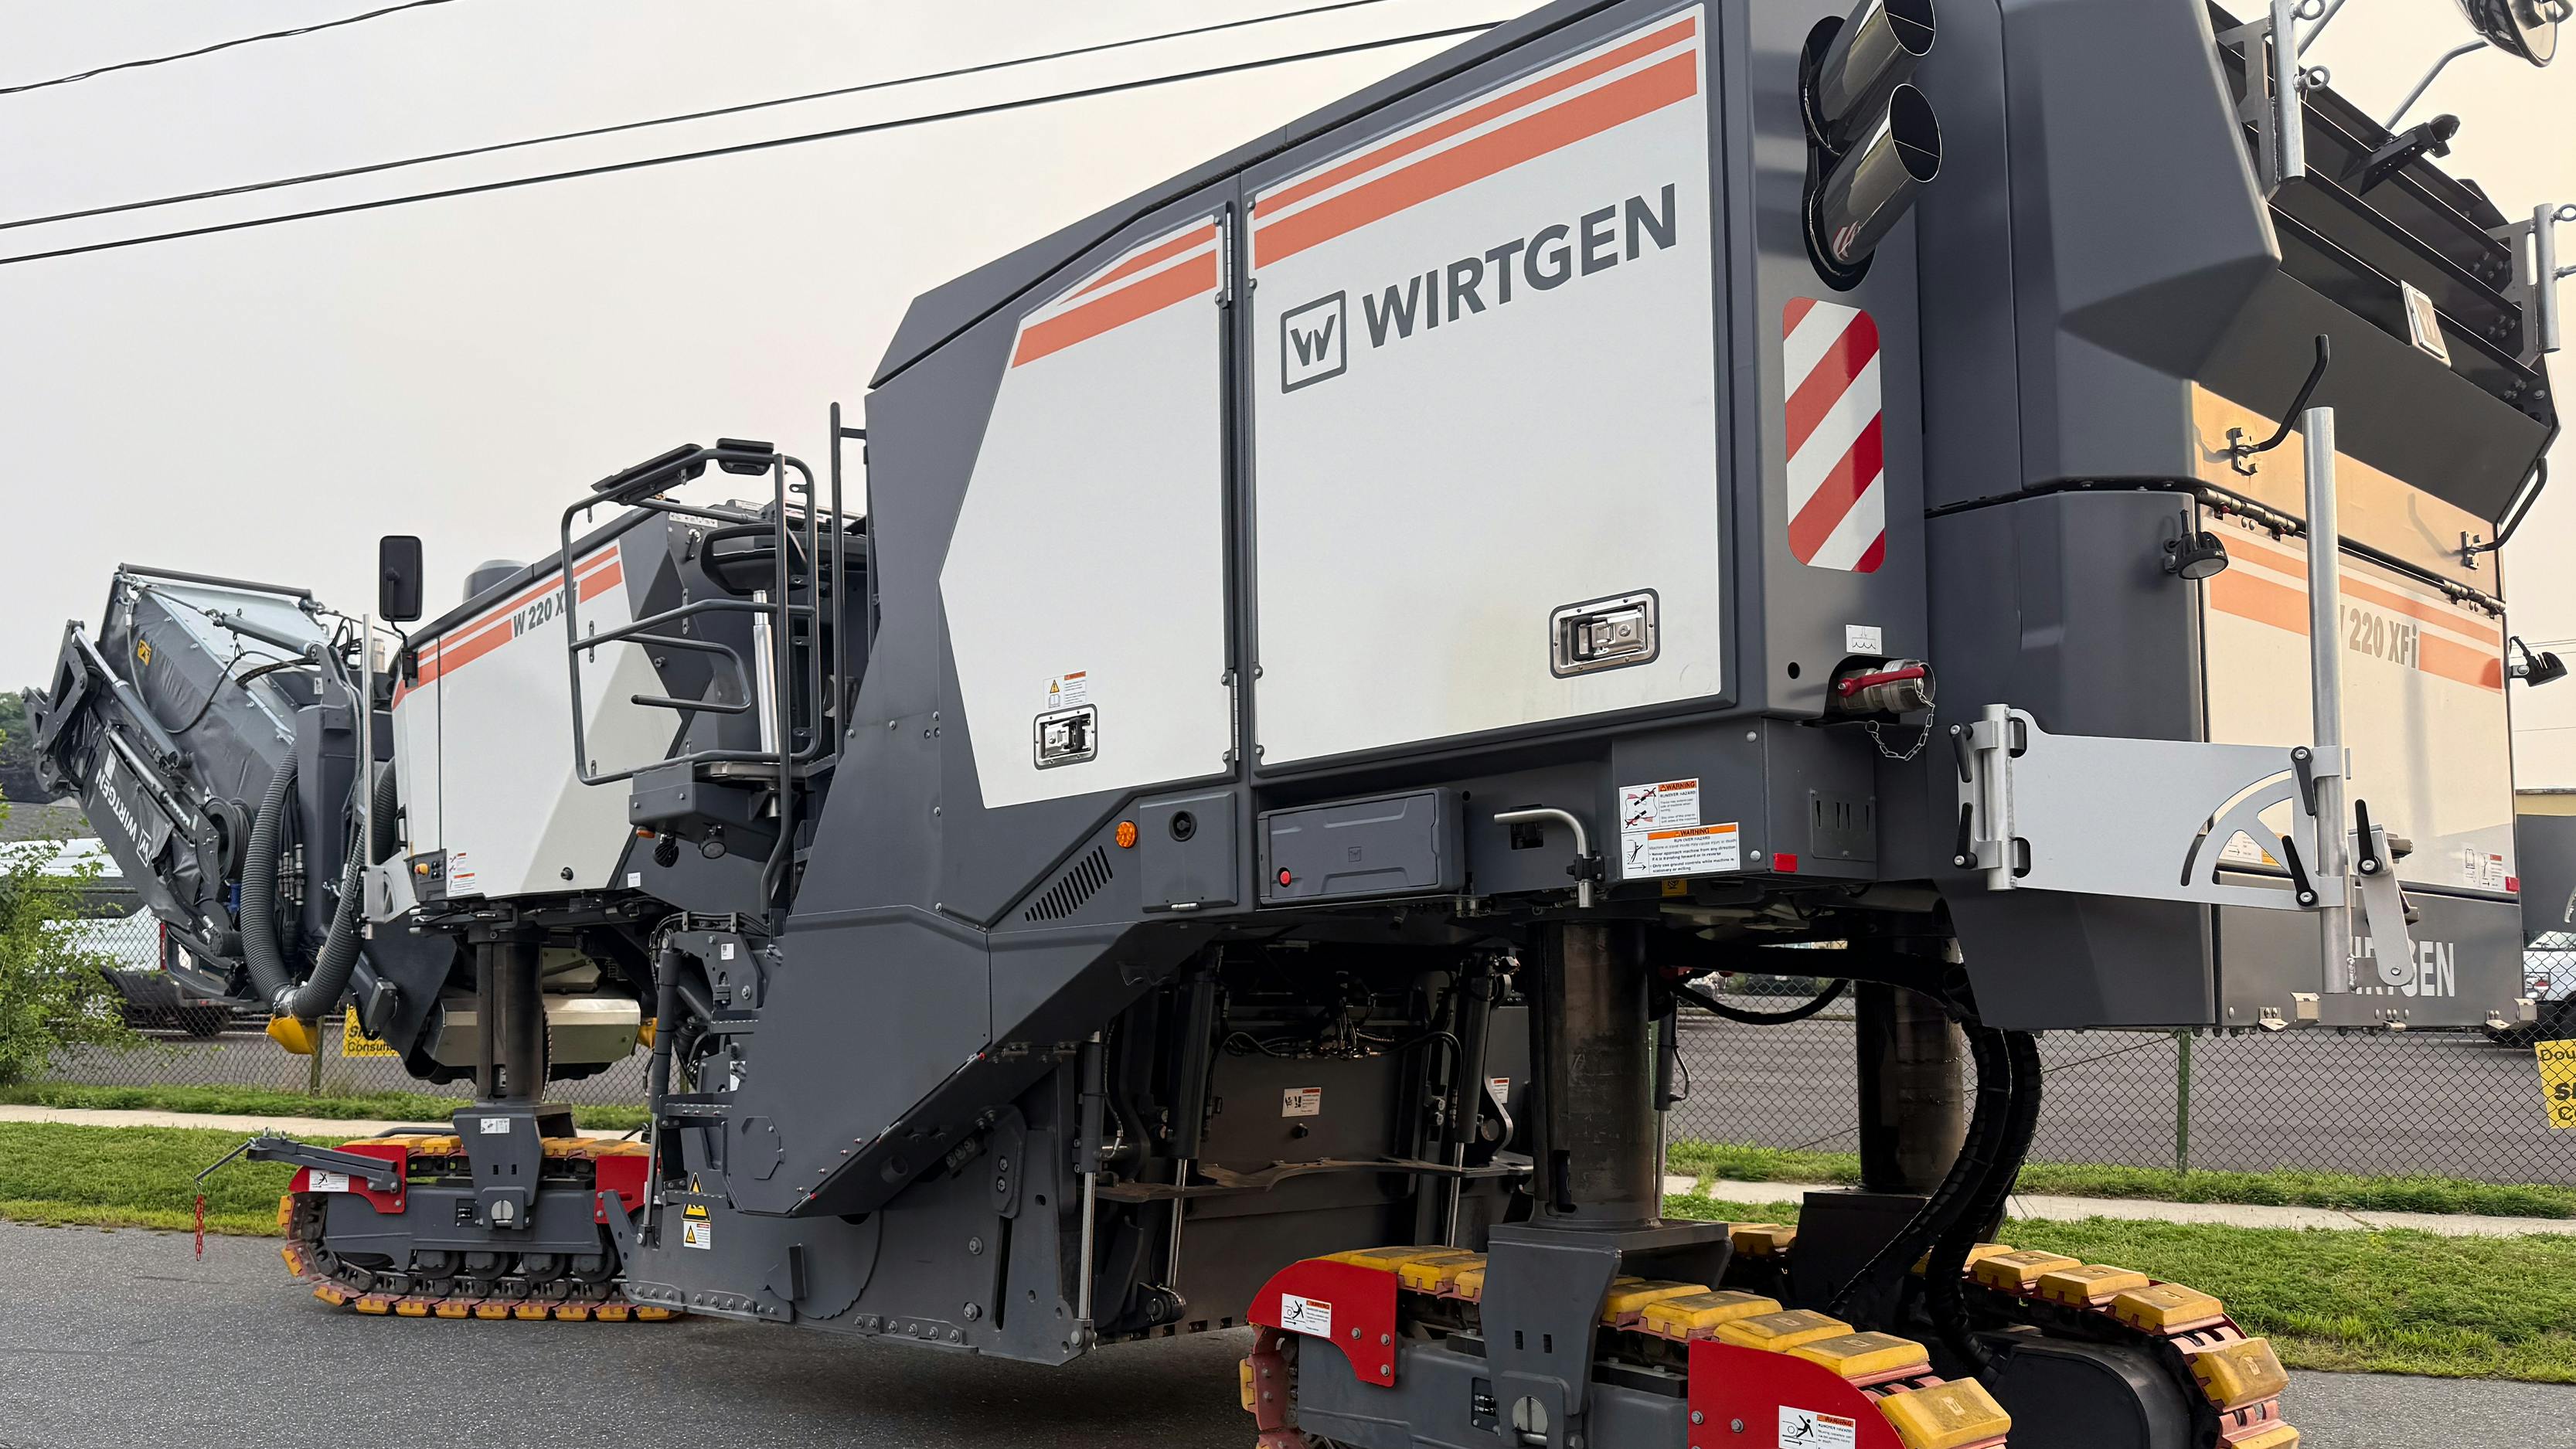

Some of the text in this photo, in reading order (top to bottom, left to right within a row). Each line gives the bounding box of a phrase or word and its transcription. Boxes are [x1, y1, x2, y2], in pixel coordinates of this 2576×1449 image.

[1362, 182, 1676, 349] WIRTGEN
[513, 610, 526, 638] W
[528, 597, 553, 631] 220
[2350, 607, 2384, 658] 220
[2387, 621, 2418, 668] XFi
[1666, 781, 1696, 791] WARNING
[95, 767, 138, 843] WIRTGEN
[1680, 828, 1710, 837] WARNING
[2554, 1082, 2576, 1101] S
[2558, 1106, 2576, 1121] C
